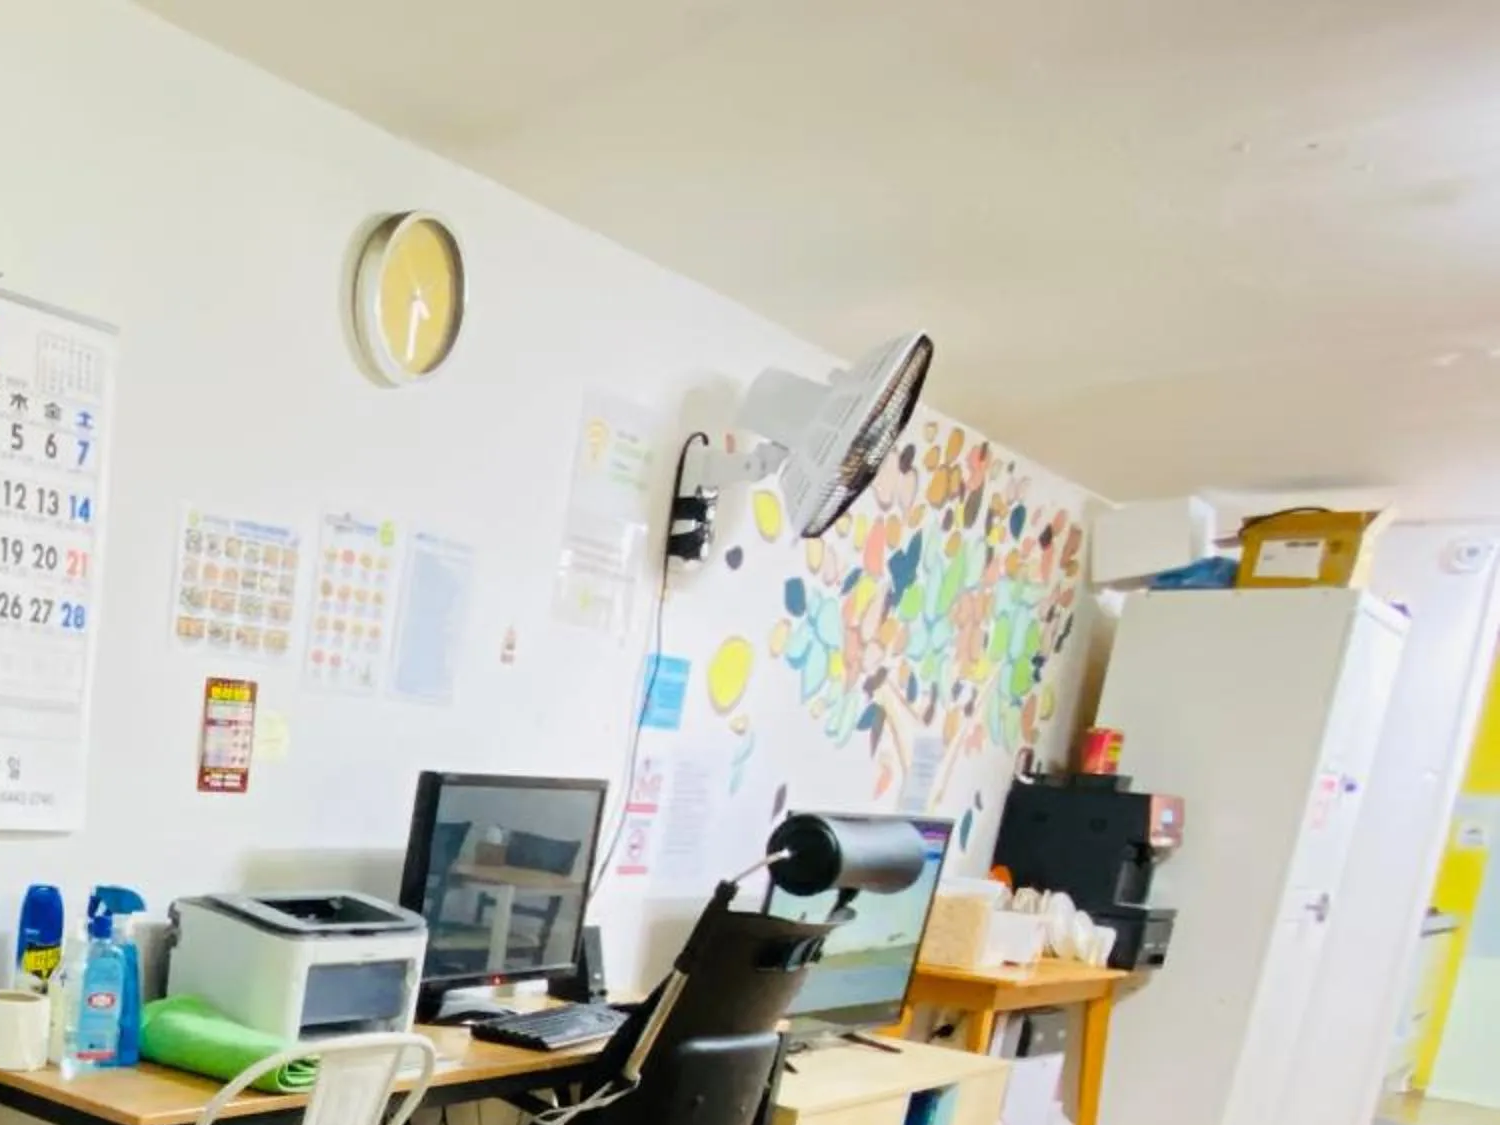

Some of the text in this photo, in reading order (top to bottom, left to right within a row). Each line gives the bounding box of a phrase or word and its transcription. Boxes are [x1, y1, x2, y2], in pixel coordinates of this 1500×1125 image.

[10, 393, 28, 411] 木
[11, 423, 24, 450] 5
[45, 433, 57, 459] 6
[77, 440, 90, 465] 7
[4, 480, 27, 510] 12
[37, 488, 59, 515] 13
[69, 495, 91, 522] 14
[0, 537, 23, 565] 19
[32, 544, 58, 570] 20
[66, 550, 88, 577] 21
[30, 599, 54, 624] 27
[60, 602, 86, 630] 28
